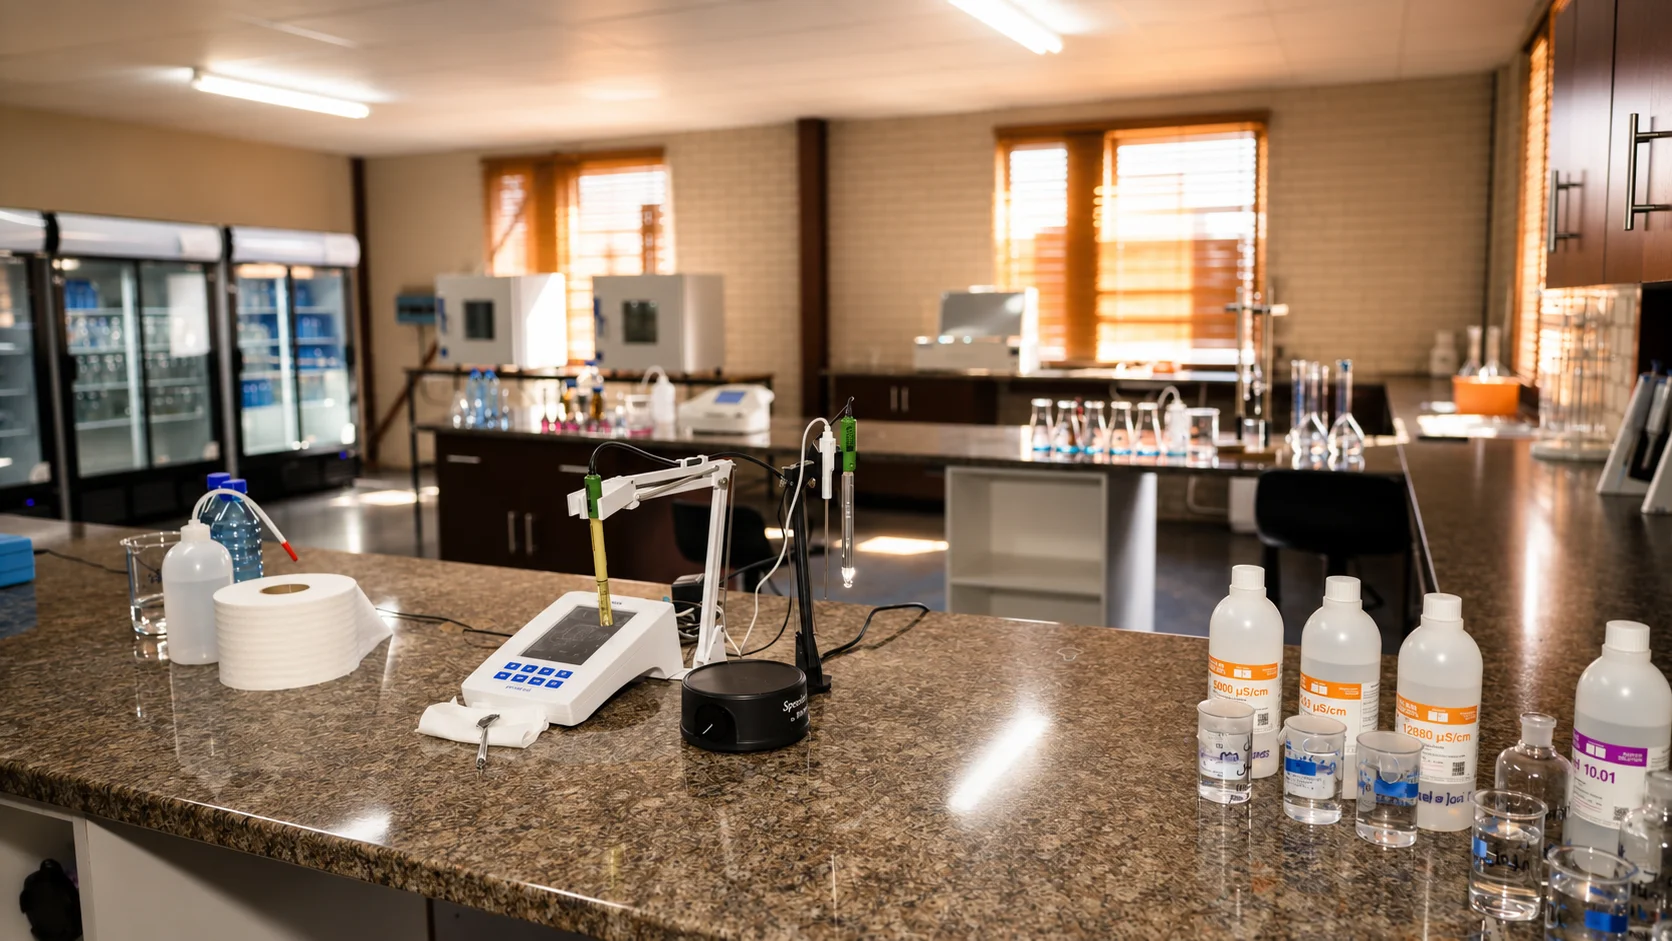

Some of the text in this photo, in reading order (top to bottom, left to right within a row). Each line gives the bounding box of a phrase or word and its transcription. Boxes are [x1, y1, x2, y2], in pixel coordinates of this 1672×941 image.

[1236, 686, 1269, 697] µS/cm
[1312, 703, 1347, 717] µS/cm
[1403, 723, 1471, 744] 12880 µS/cm
[1584, 763, 1616, 785] 10.01
